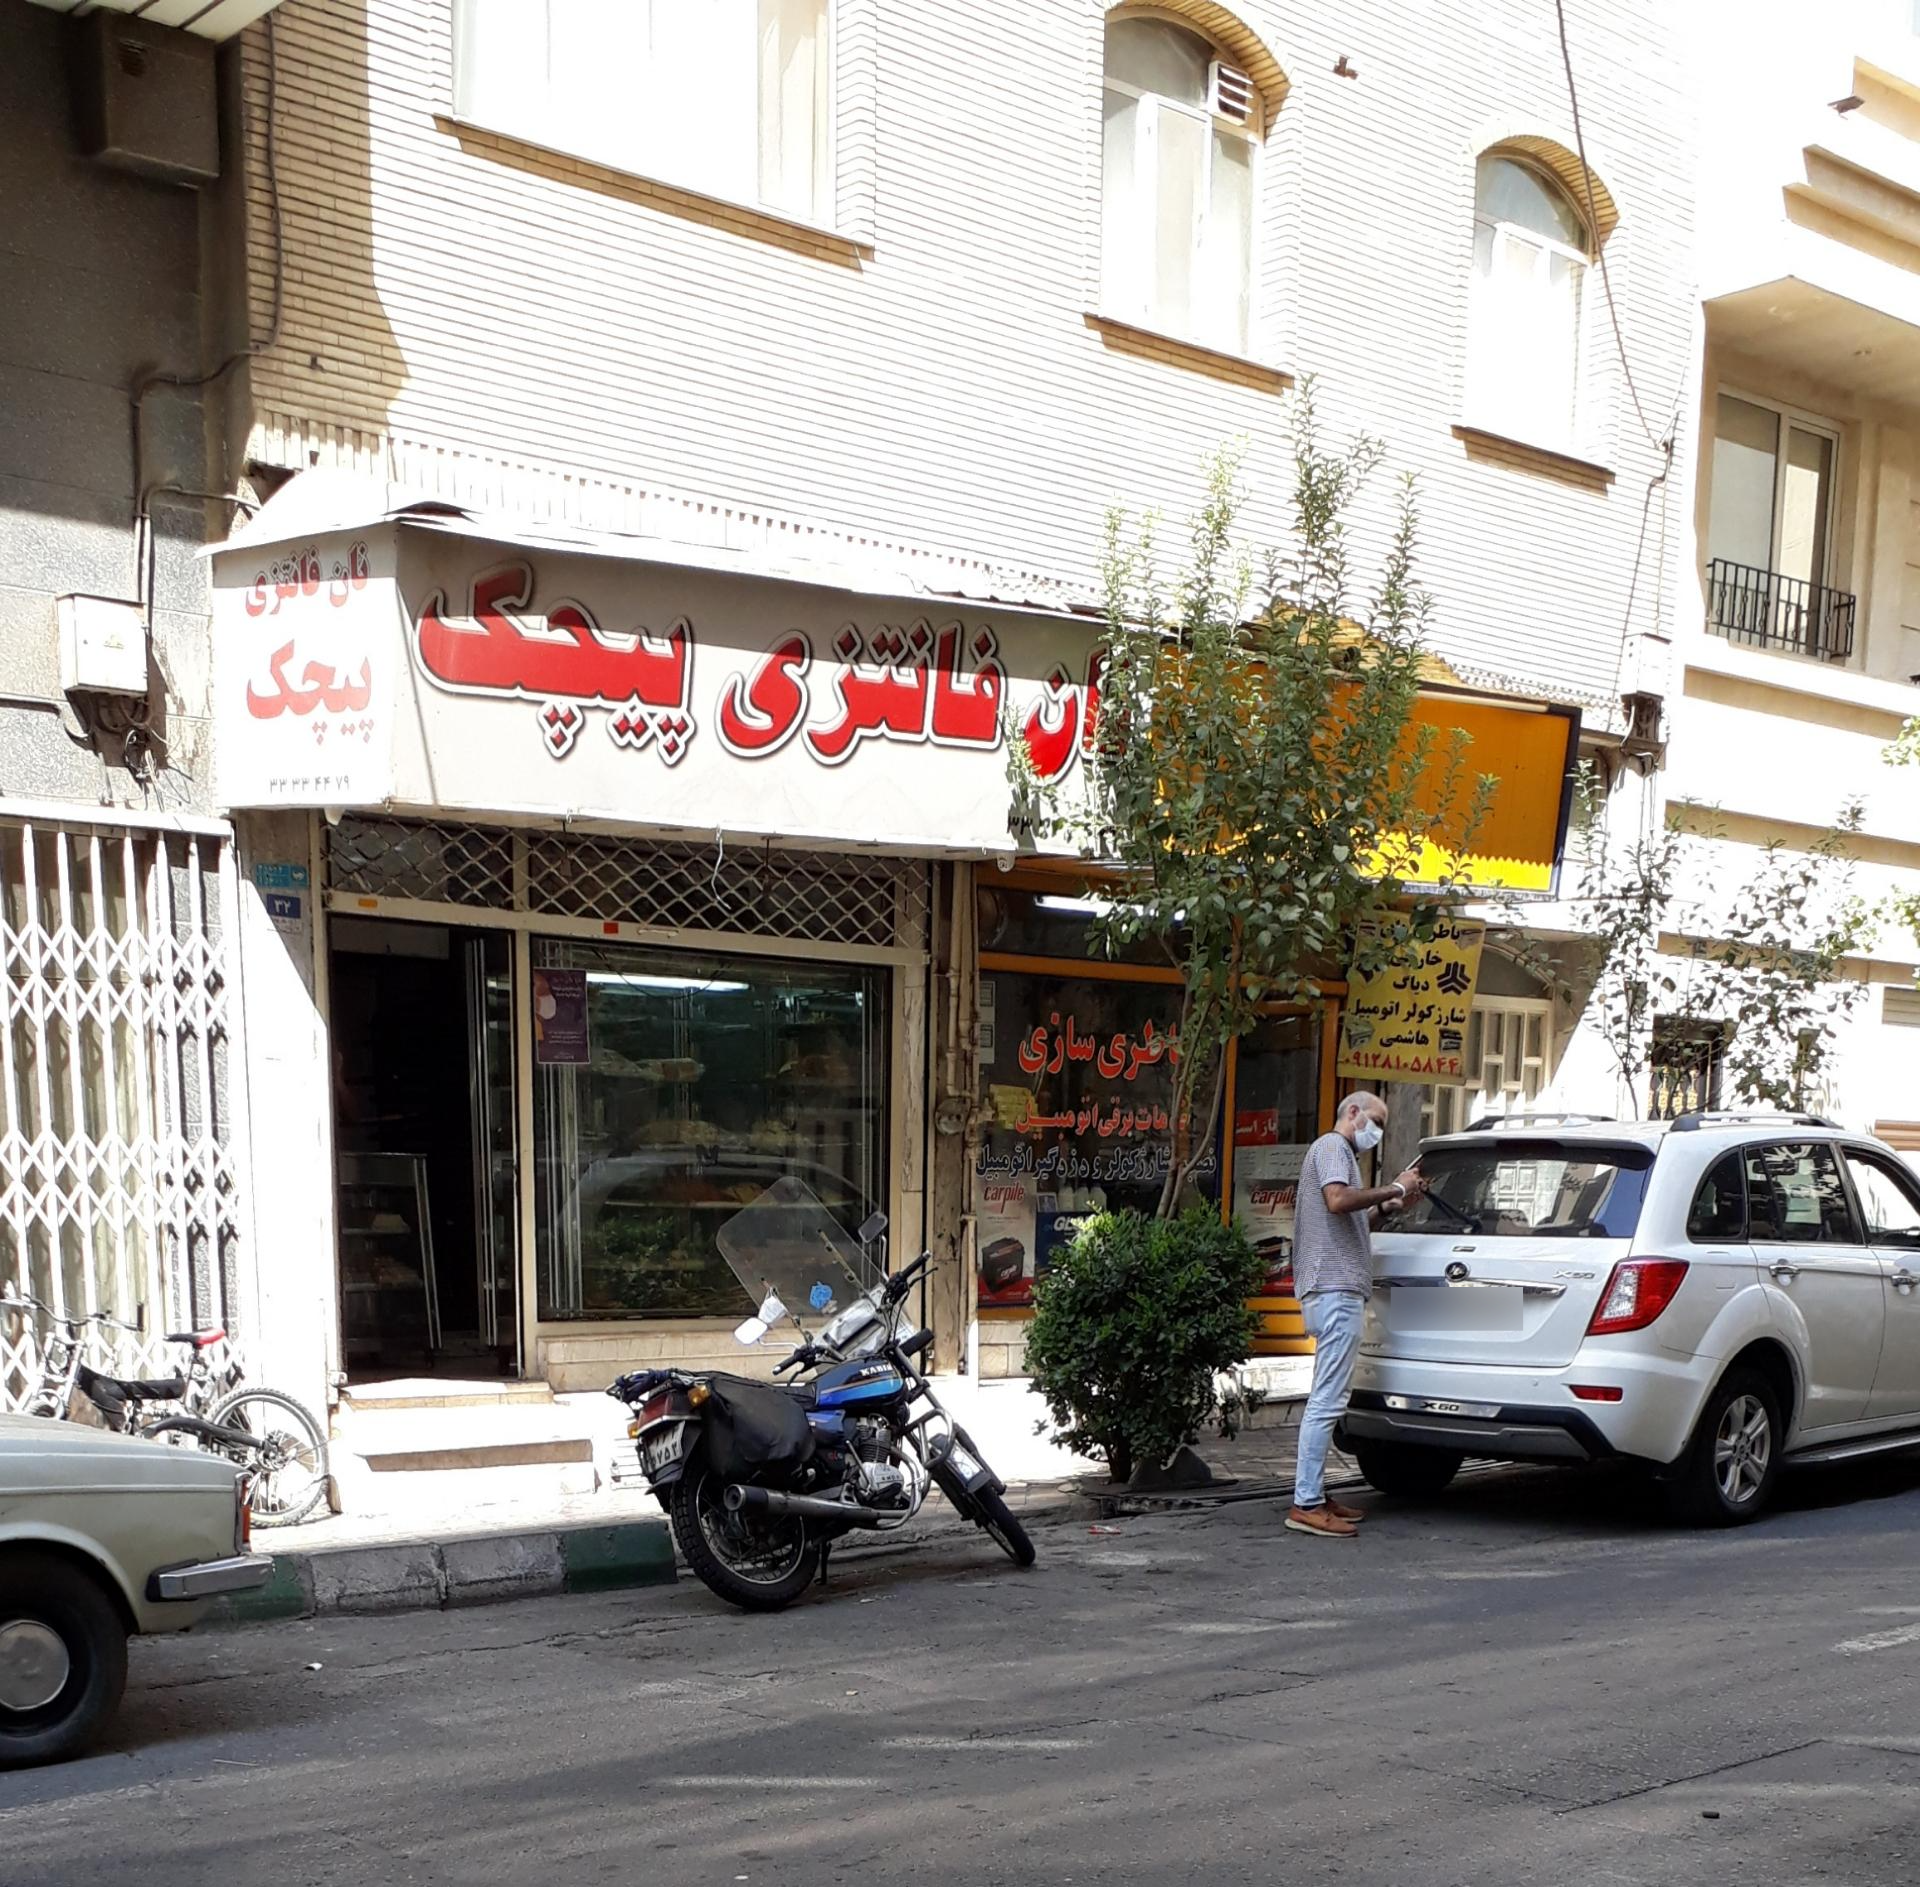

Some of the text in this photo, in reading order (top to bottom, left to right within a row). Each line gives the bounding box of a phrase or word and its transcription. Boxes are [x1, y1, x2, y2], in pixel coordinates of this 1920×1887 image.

[245, 539, 371, 618] نان فانتزی
[412, 558, 696, 767] پیچک
[246, 638, 375, 746] پیچک
[714, 616, 1007, 768] فانتزی
[1413, 924, 1460, 945] باطر
[1350, 997, 1400, 1021] اتومبیل
[1401, 1001, 1436, 1024] کولر
[1018, 1012, 1180, 1081] اطری سازی
[1379, 1029, 1430, 1048] هاشمی
[1015, 1094, 1098, 1141] اتومبیل
[1098, 1095, 1135, 1138] برقی
[1134, 1097, 1190, 1131] خمات
[983, 1181, 1025, 1215] carpile
